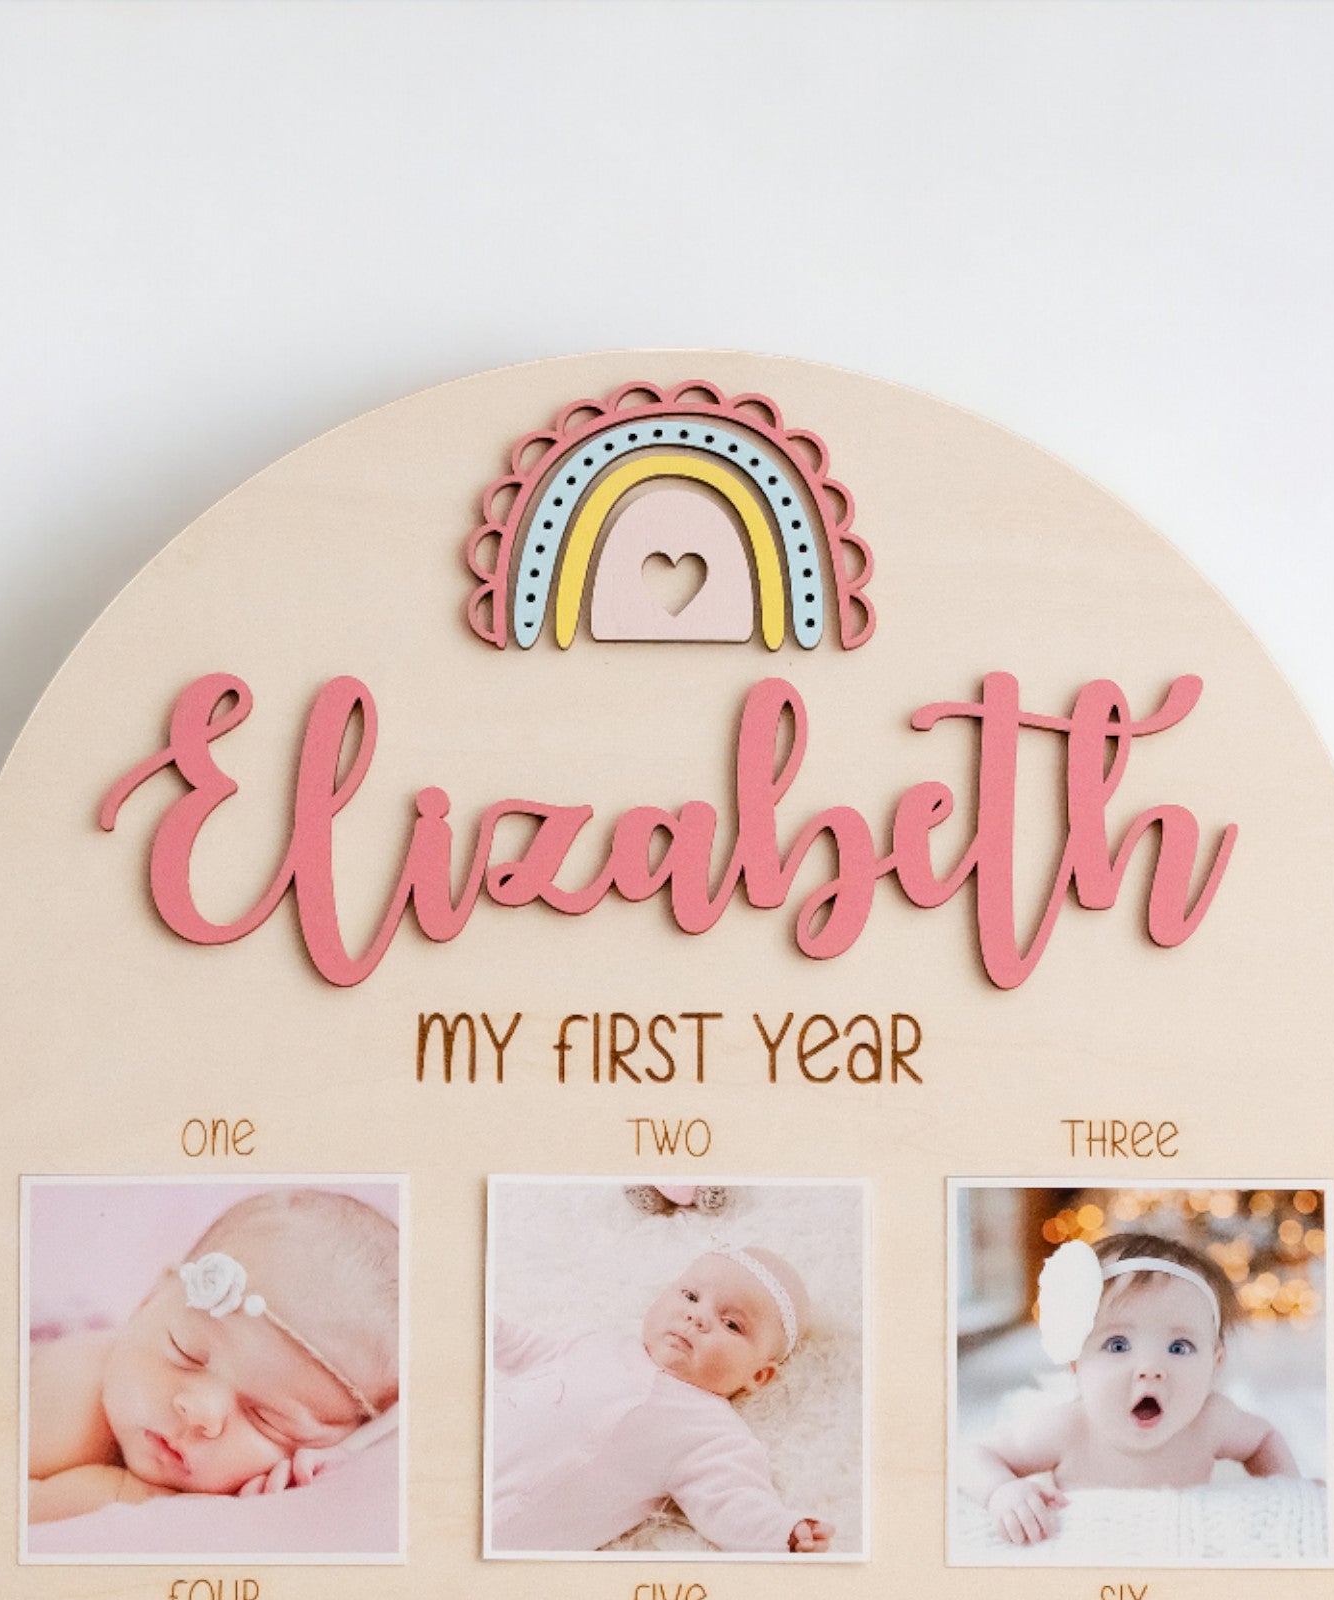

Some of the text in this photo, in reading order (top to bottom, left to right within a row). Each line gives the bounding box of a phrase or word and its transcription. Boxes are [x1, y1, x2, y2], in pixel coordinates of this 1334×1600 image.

[98, 672, 1237, 988] Elizabeth
[416, 1012, 522, 1084] MY
[627, 1118, 711, 1157] TWO
